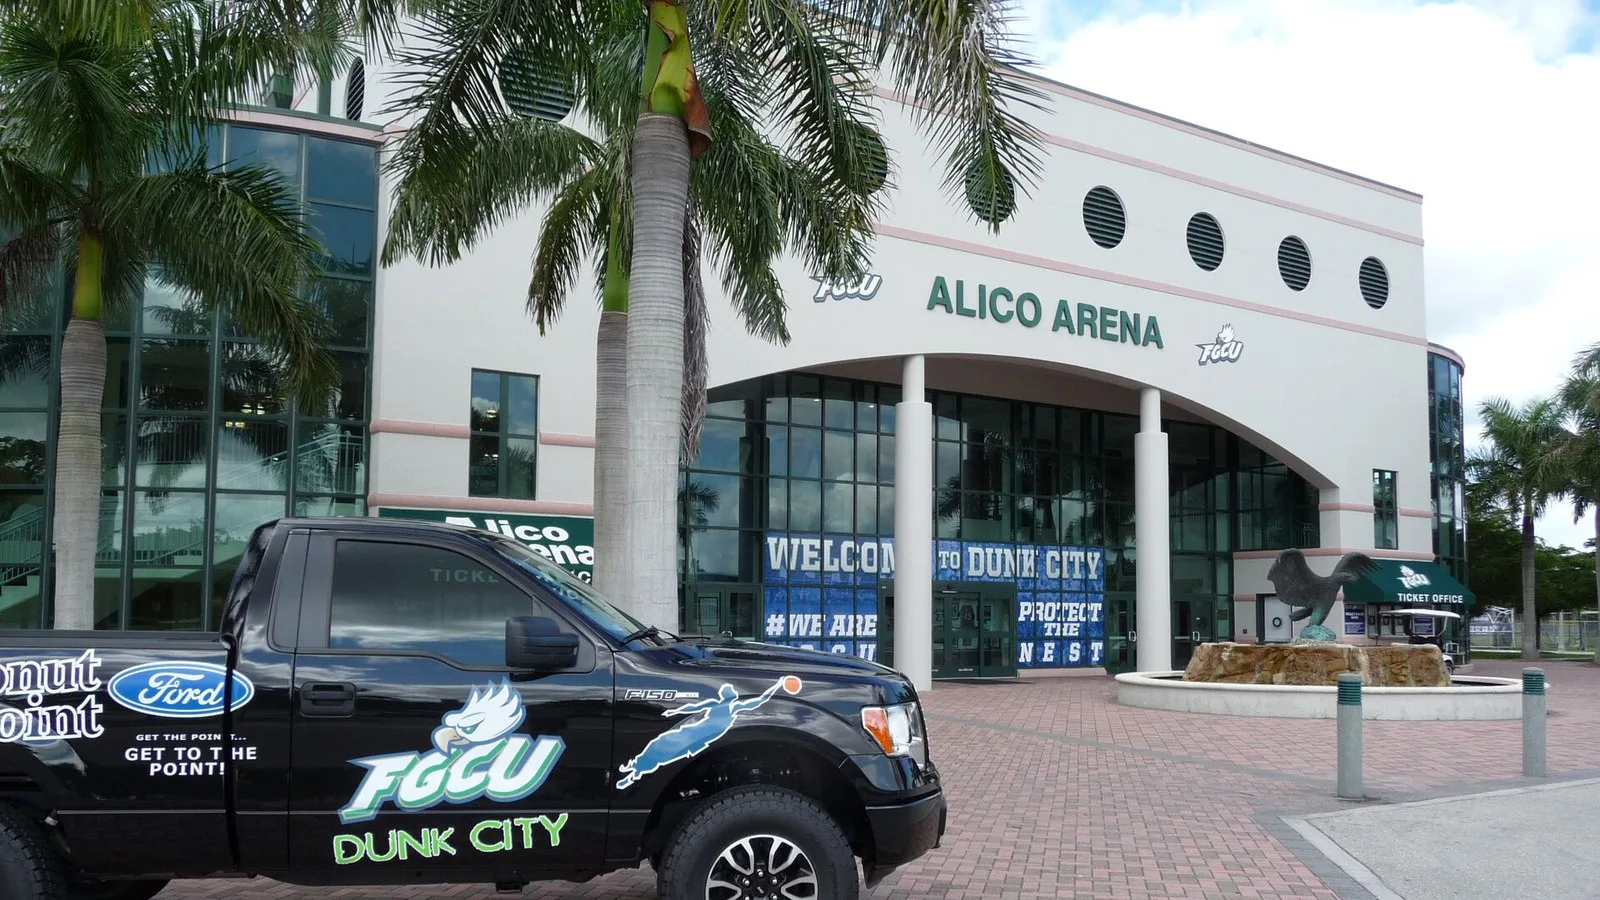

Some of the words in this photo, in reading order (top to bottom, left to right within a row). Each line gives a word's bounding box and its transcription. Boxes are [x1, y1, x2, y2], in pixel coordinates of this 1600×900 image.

[927, 275, 1043, 328] ALICO
[1052, 299, 1164, 349] ARENA
[1195, 340, 1244, 366] FGCU
[938, 550, 961, 570] TO
[967, 546, 1039, 578] DUNK
[1045, 550, 1101, 580] CITY
[1018, 601, 1102, 622] PROTECT
[1397, 593, 1430, 603] TICKET
[1432, 594, 1464, 604] OFFICE
[829, 613, 878, 637] ARE
[1044, 622, 1081, 637] THE
[0, 648, 102, 696] nut
[138, 671, 227, 706] Ford
[0, 692, 105, 743] oint
[136, 733, 159, 741] GET
[163, 733, 187, 741] THE
[124, 747, 166, 761] GET
[174, 747, 202, 761] TO
[149, 762, 225, 777] POINT!
[337, 733, 567, 825] FGCU
[333, 827, 456, 865] DUNK
[469, 812, 569, 853] CITY
